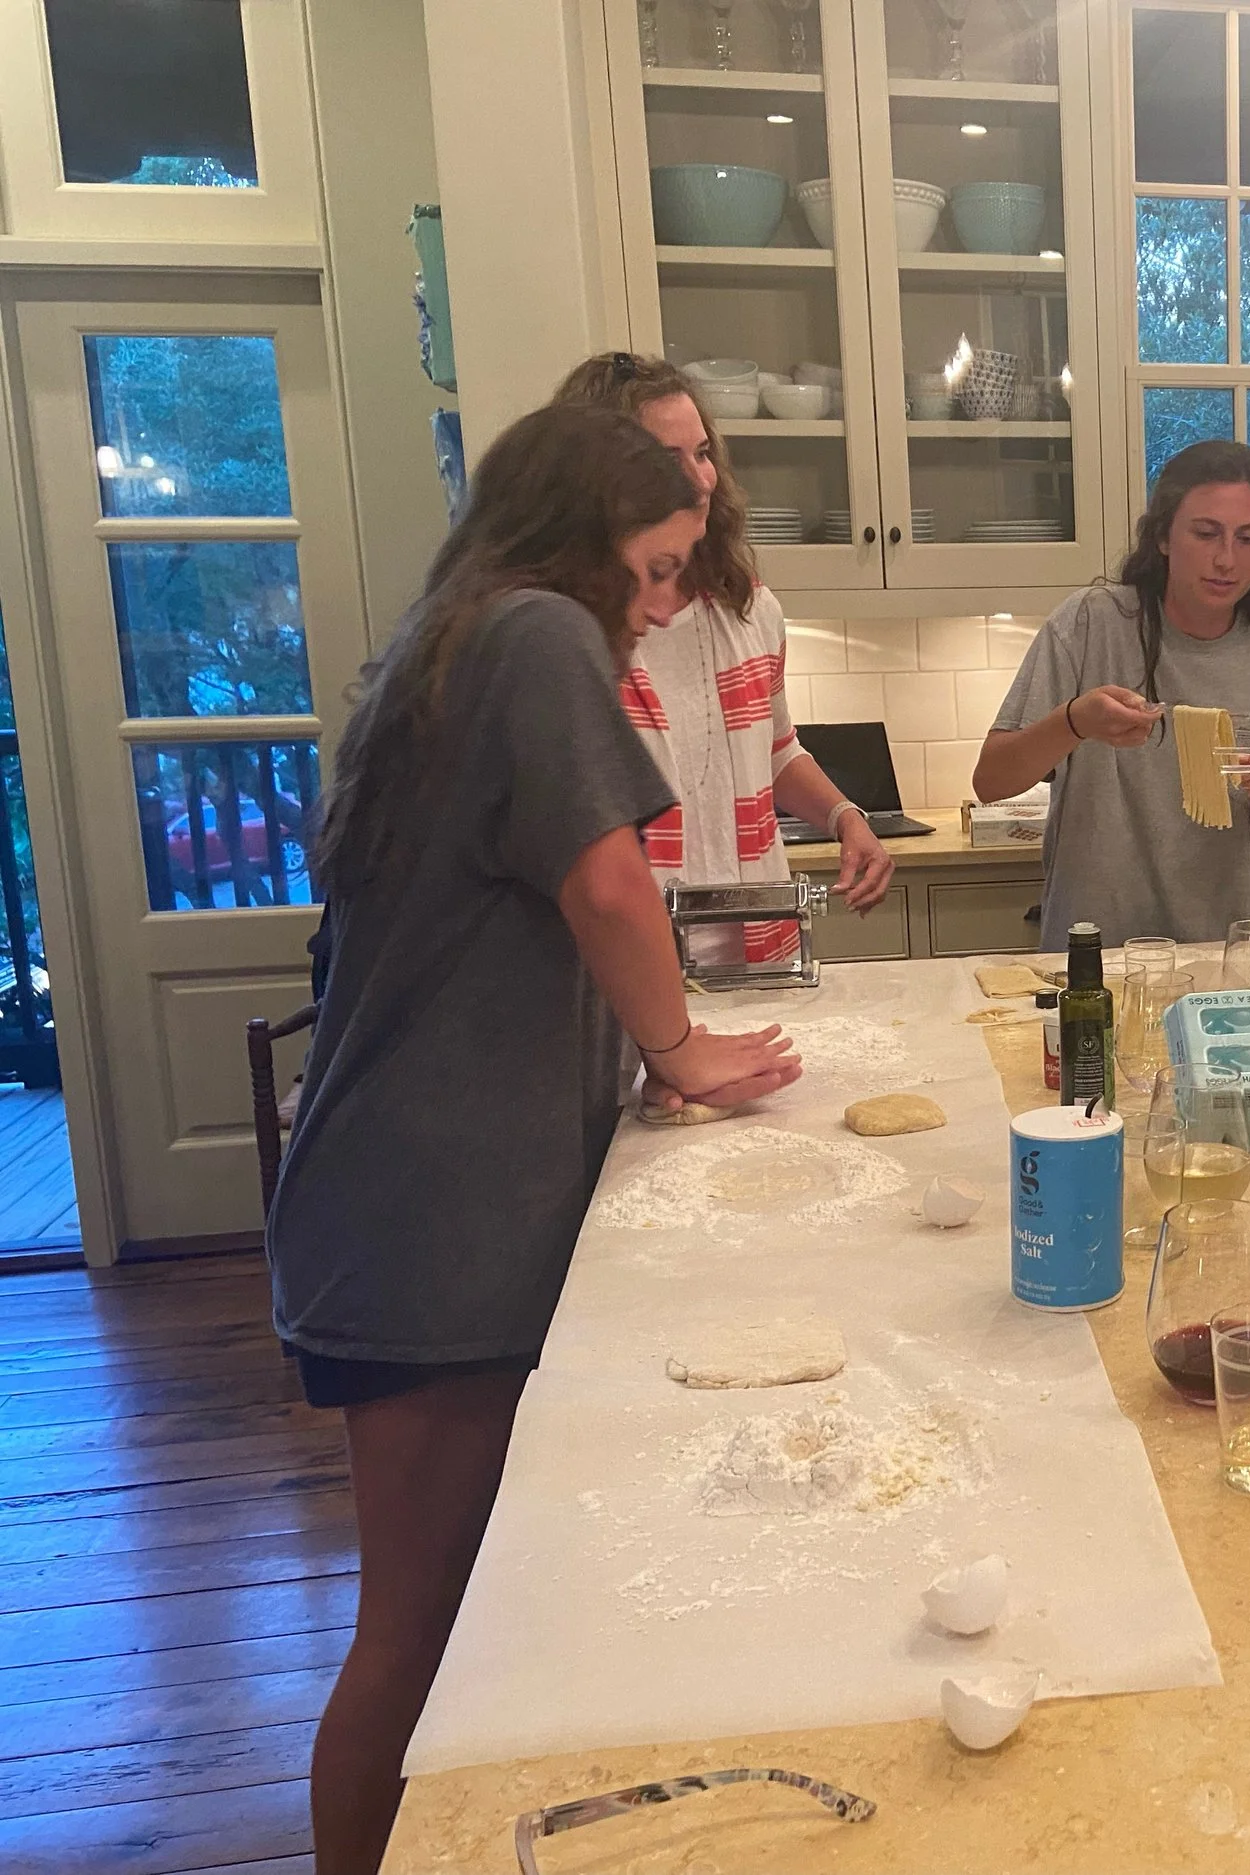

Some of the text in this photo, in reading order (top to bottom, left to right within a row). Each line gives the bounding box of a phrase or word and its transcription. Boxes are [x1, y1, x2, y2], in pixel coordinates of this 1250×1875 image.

[1188, 997, 1219, 1006] EGGS
[1237, 995, 1245, 1003] A
[1020, 1243, 1043, 1260] Salt
